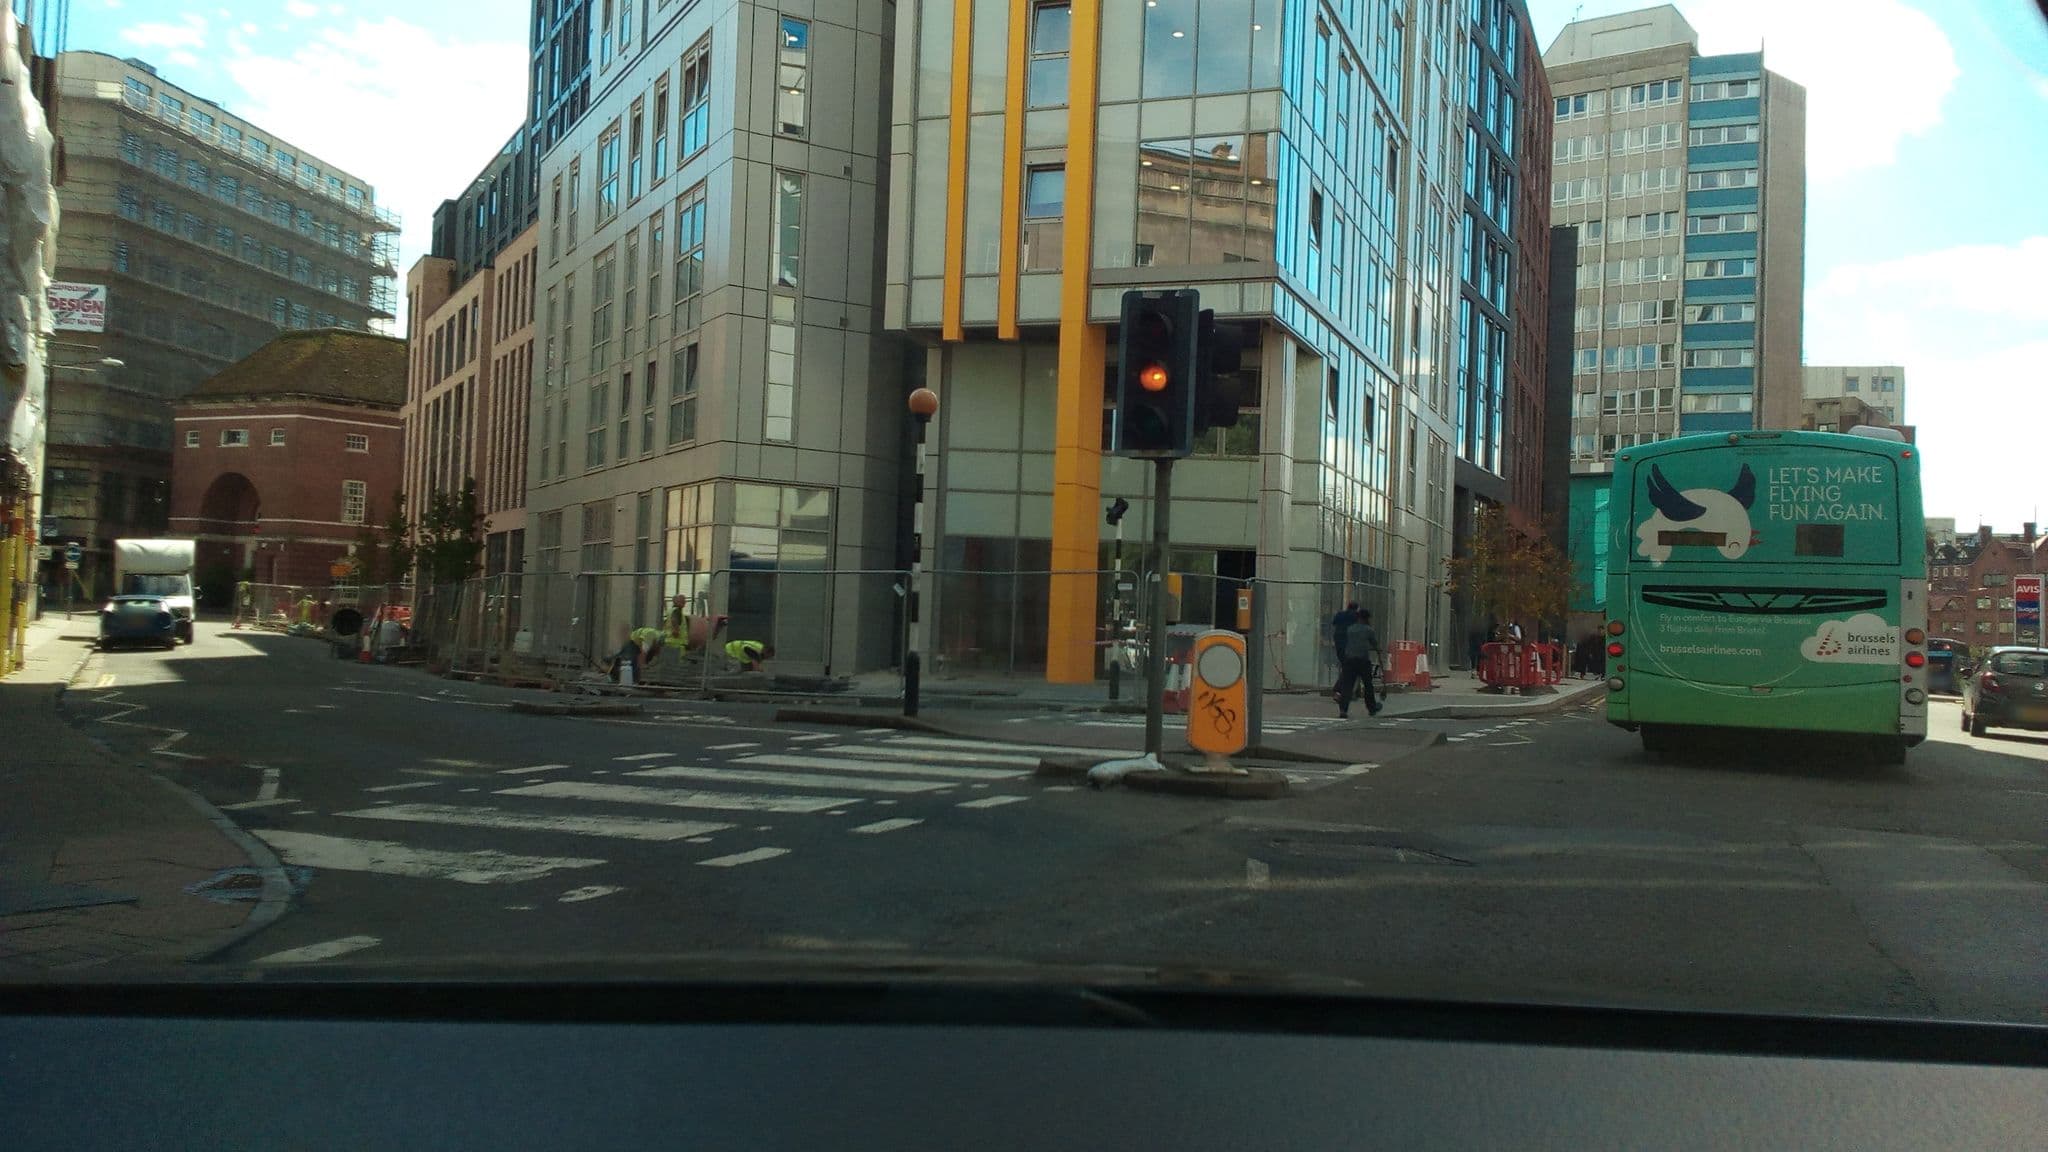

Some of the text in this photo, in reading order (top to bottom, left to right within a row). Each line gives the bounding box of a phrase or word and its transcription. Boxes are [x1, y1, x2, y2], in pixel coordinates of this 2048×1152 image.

[48, 296, 104, 313] DESIGN
[1769, 466, 1882, 483] LET'S MAKE
[1769, 485, 1841, 502] FLYING
[1769, 503, 1888, 520] FUN AGAIN.
[2016, 585, 2040, 593] AVIS
[1717, 614, 1727, 622] to
[1847, 632, 1896, 644] brussels
[1660, 644, 1762, 656] brusselsairlines.com
[1847, 645, 1891, 656] airlines
